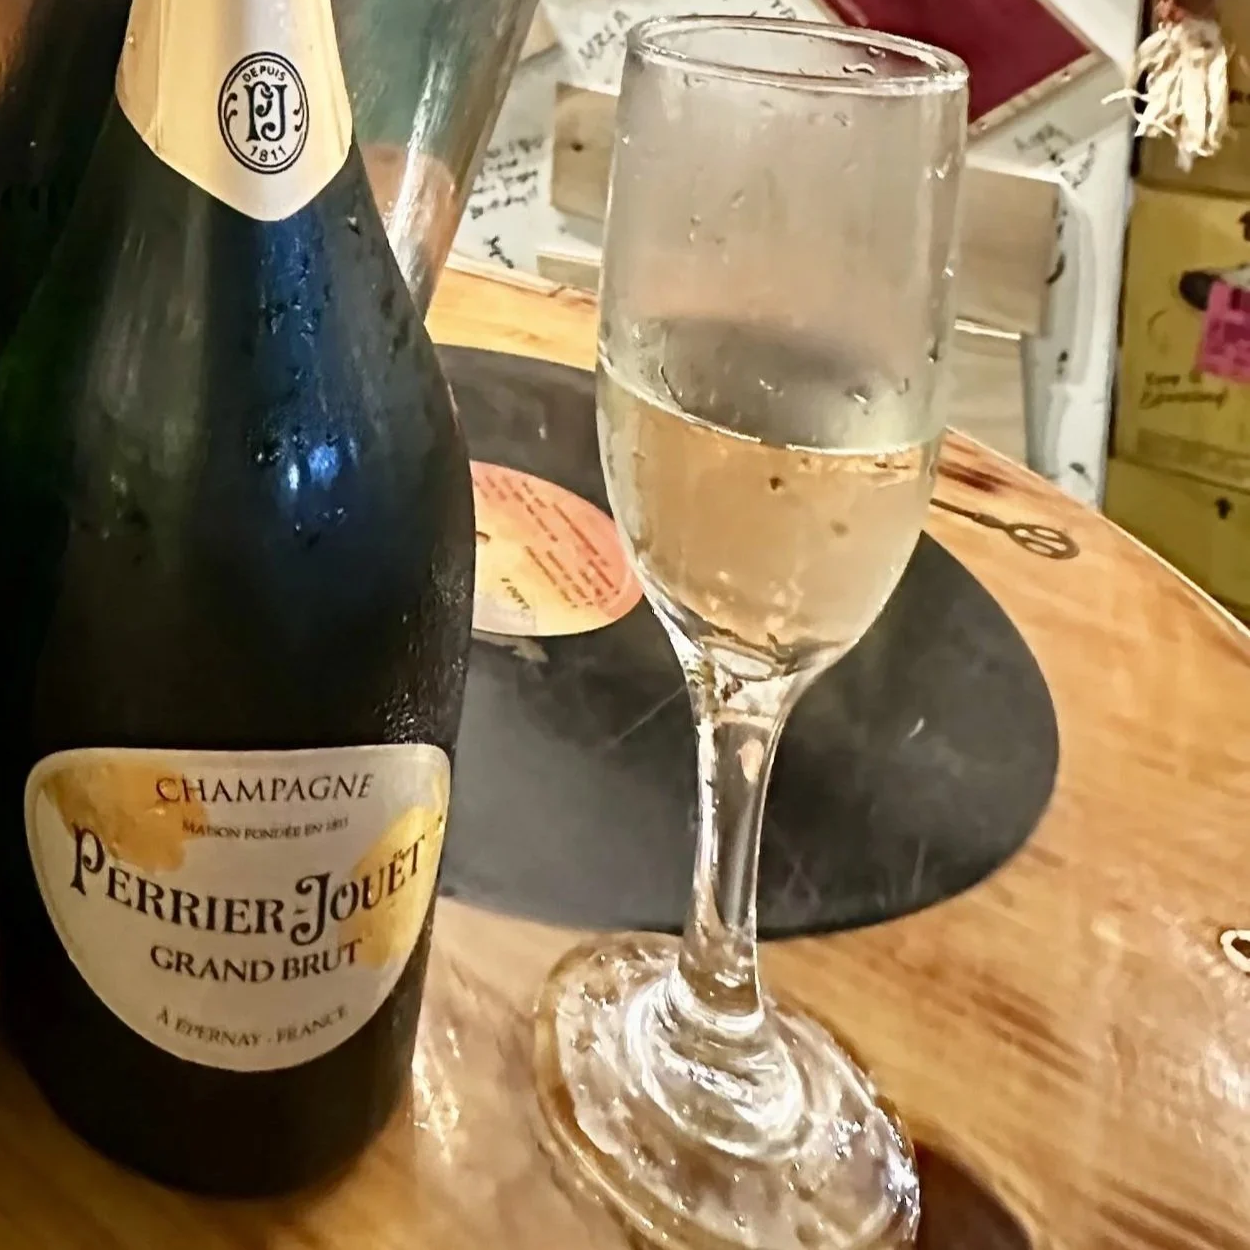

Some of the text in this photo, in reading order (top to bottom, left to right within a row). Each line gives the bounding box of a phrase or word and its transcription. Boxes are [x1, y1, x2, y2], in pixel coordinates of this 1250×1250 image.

[242, 64, 286, 83] DEPUIS
[248, 143, 288, 162] 1811
[154, 771, 375, 804] CHAMPAGNE
[149, 936, 364, 984] GRAND BRUT
[276, 1004, 349, 1045] FRANCE
